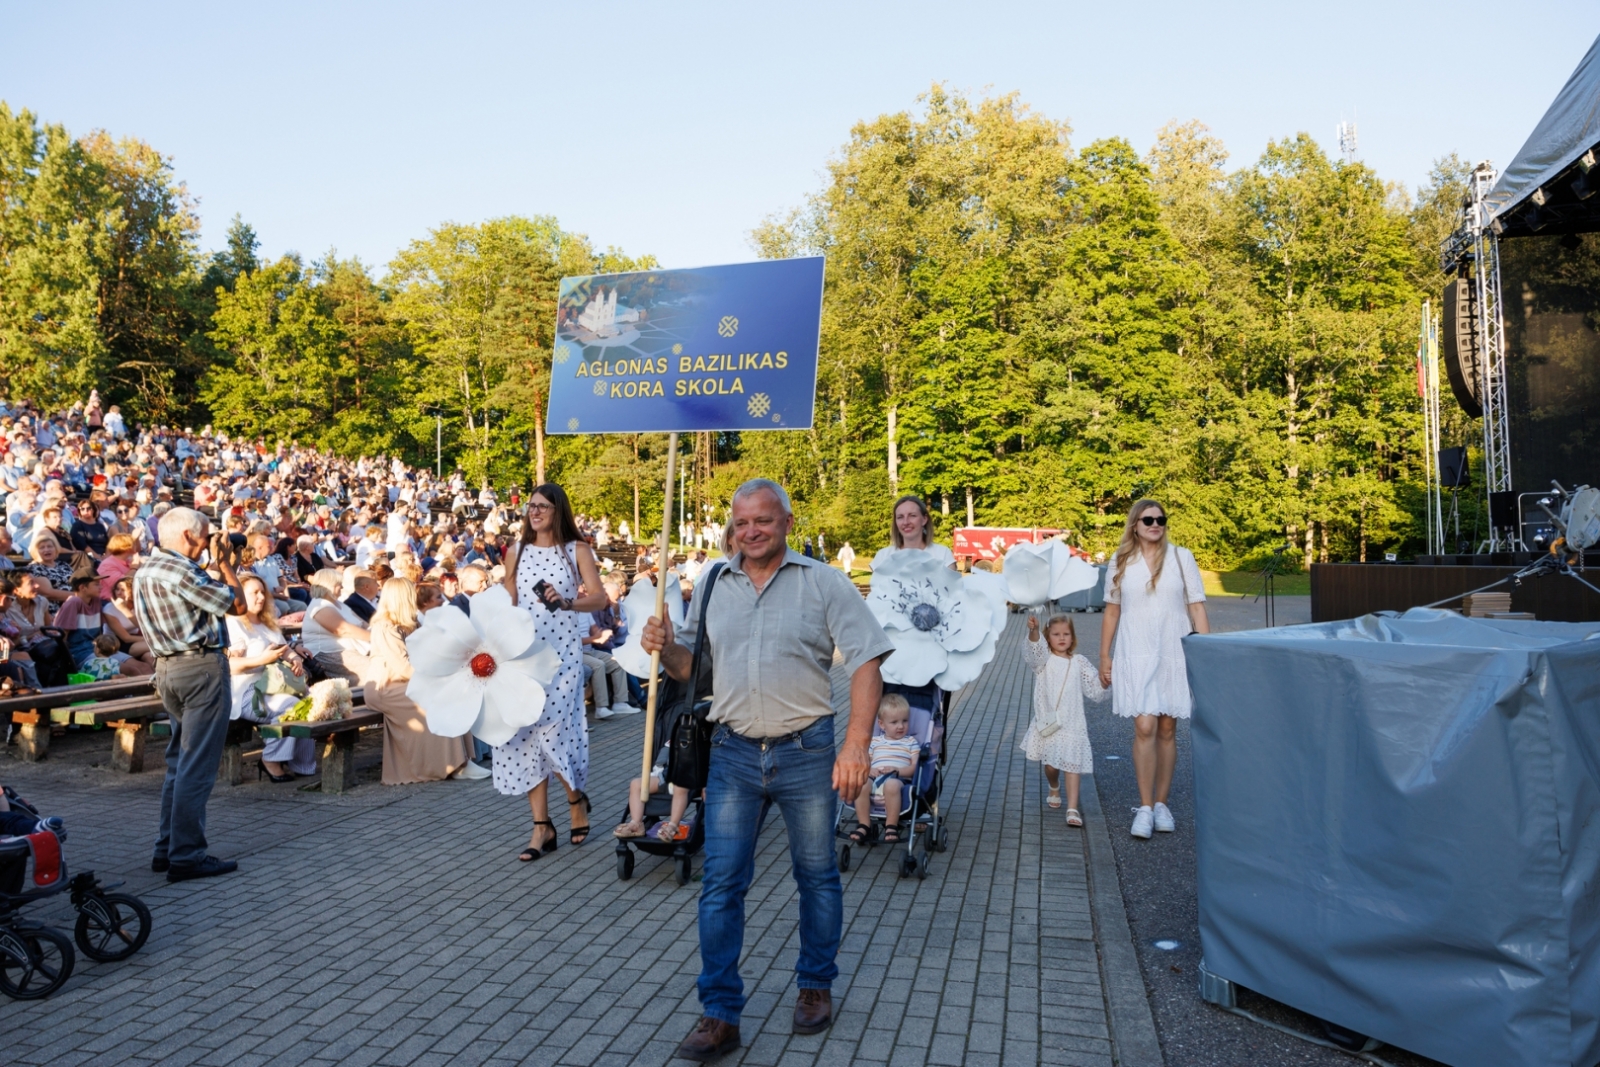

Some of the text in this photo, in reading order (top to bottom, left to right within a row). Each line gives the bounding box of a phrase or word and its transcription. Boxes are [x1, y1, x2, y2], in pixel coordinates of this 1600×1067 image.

[575, 351, 788, 378] AGLONAS BAZILIKAS
[610, 377, 744, 398] KORA SKOLA
